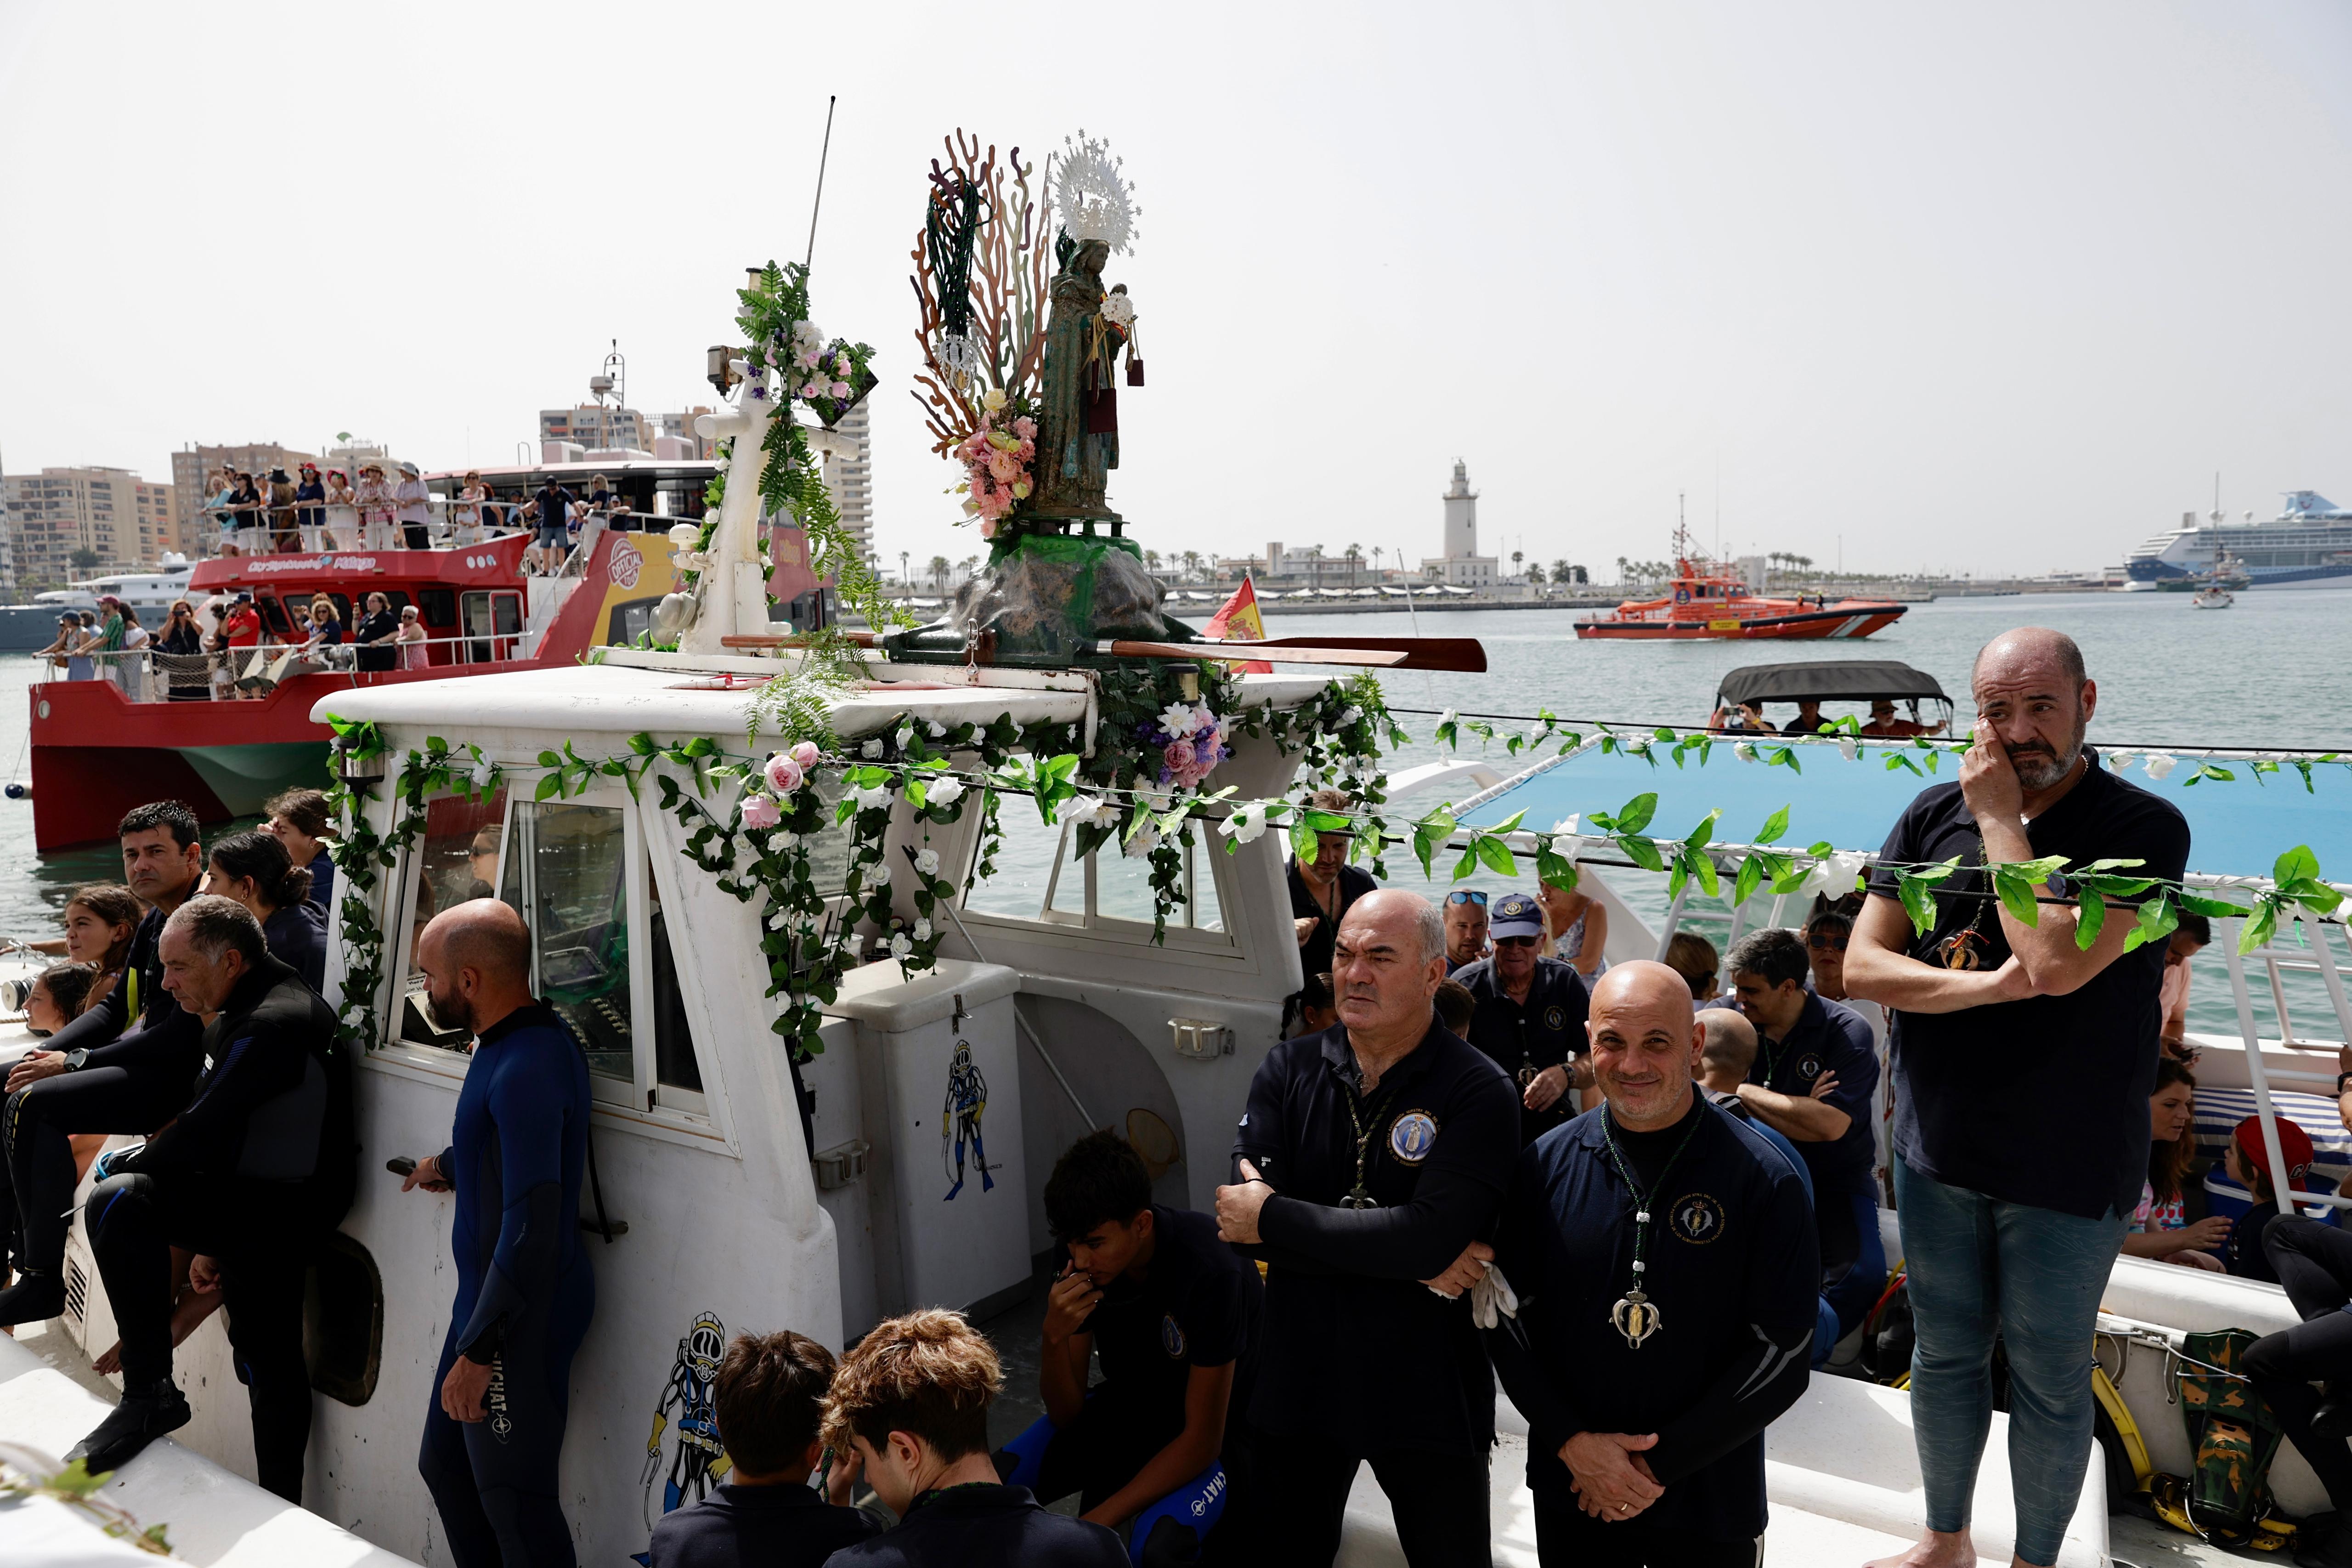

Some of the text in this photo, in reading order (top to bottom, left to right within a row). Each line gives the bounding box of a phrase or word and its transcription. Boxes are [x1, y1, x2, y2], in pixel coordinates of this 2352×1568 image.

[611, 553, 642, 579] OFFICIAL
[623, 569, 637, 586] TOUR
[6, 1096, 19, 1143] CRESSI
